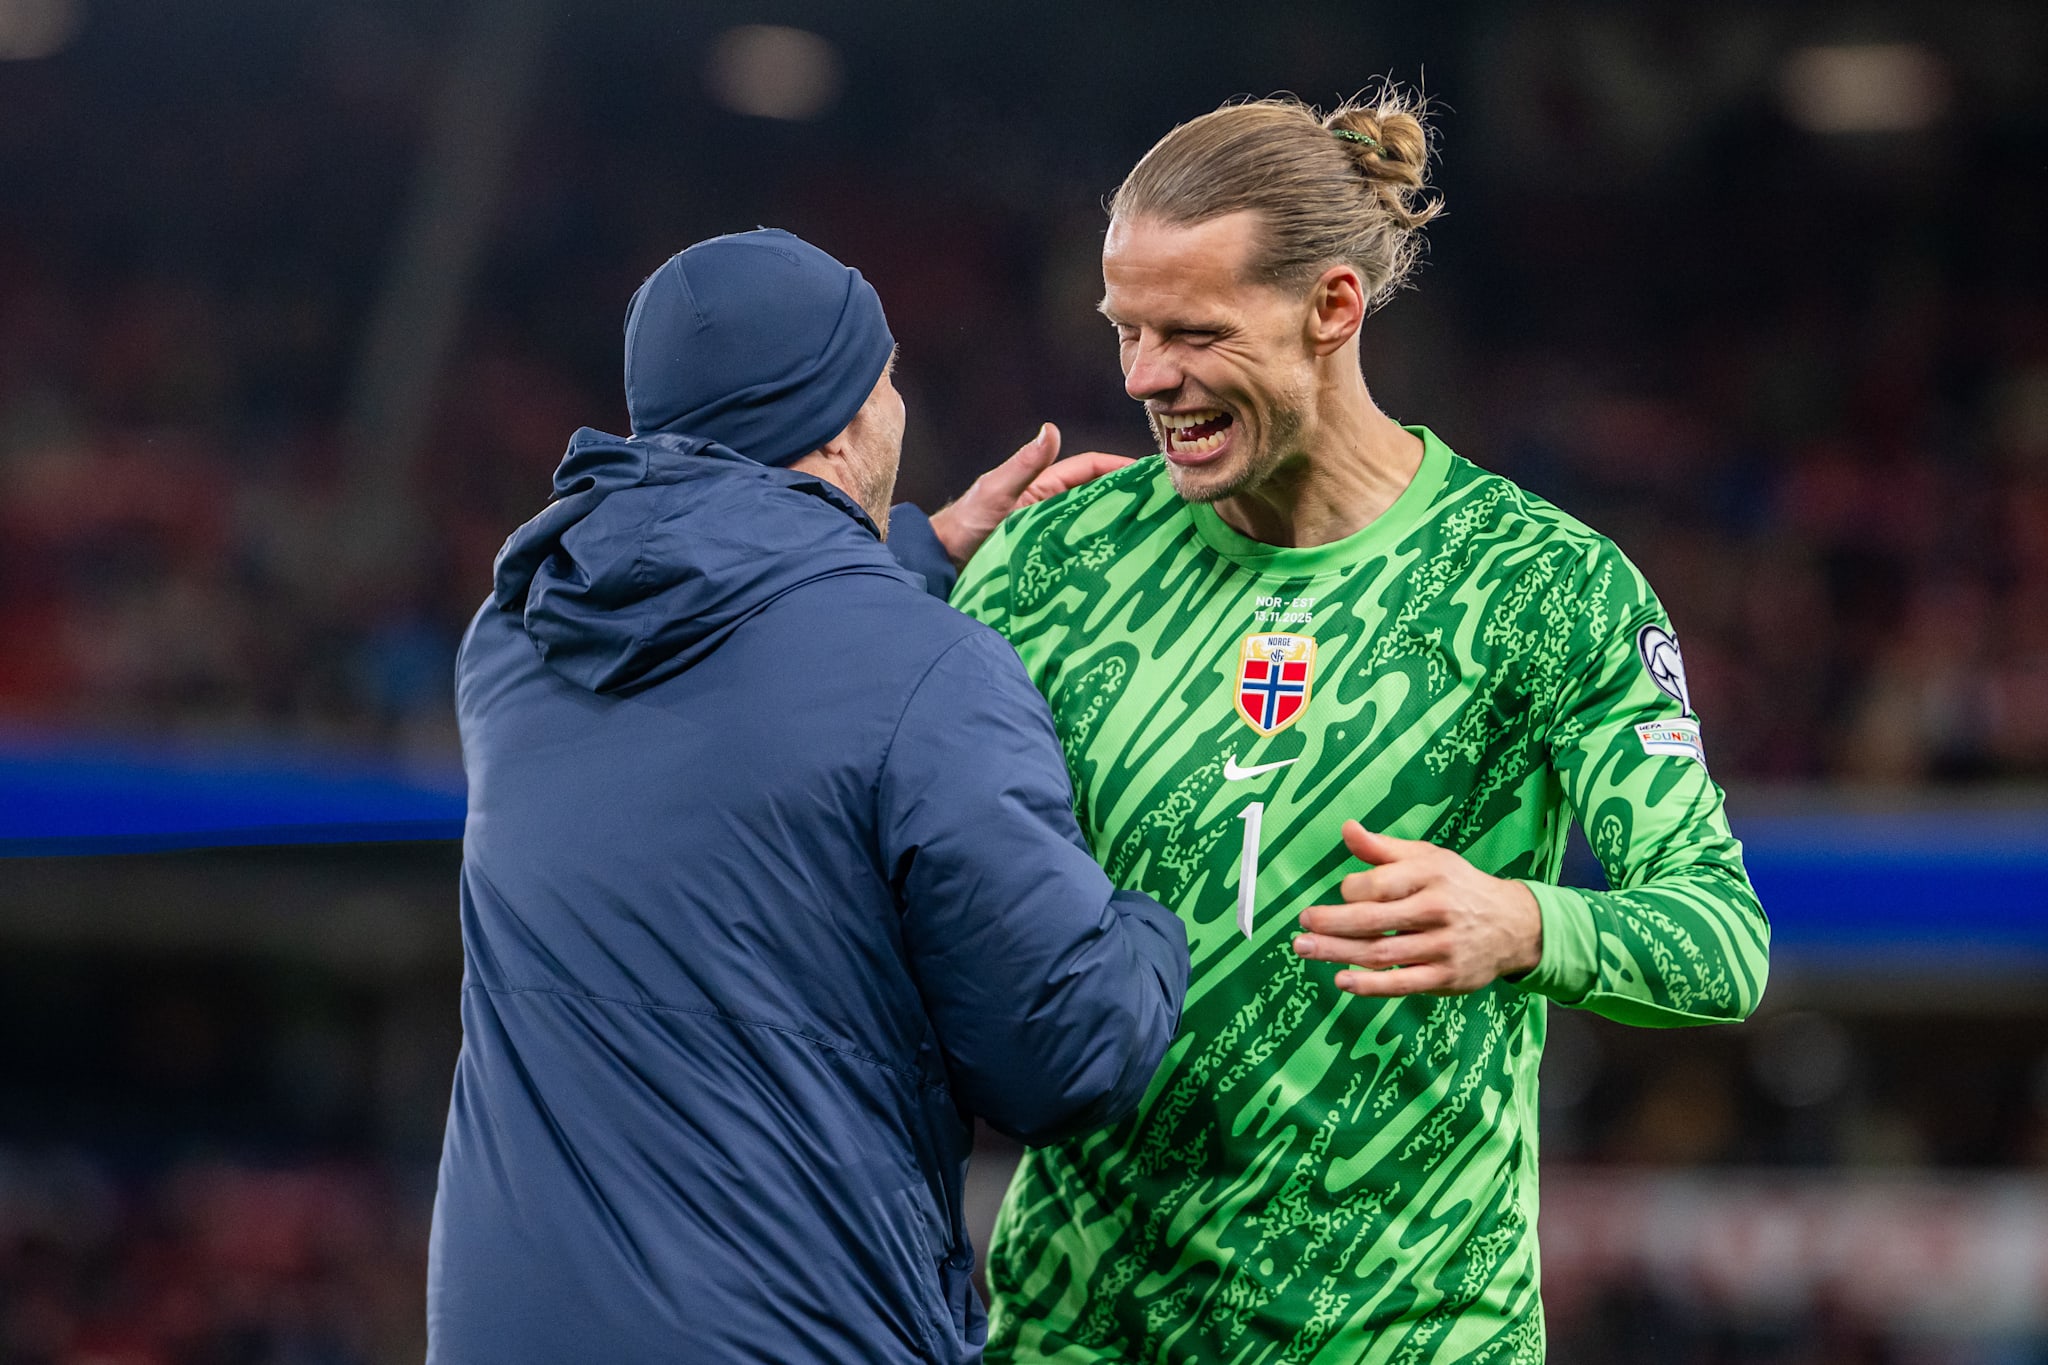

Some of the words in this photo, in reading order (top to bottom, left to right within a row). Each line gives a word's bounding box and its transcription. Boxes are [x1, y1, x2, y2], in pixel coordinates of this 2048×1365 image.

[1256, 597, 1282, 608] NOR
[1292, 598, 1315, 608] EST
[1254, 611, 1312, 623] 13.11.2025
[1267, 637, 1292, 646] NORGE
[1236, 801, 1264, 941] 1
